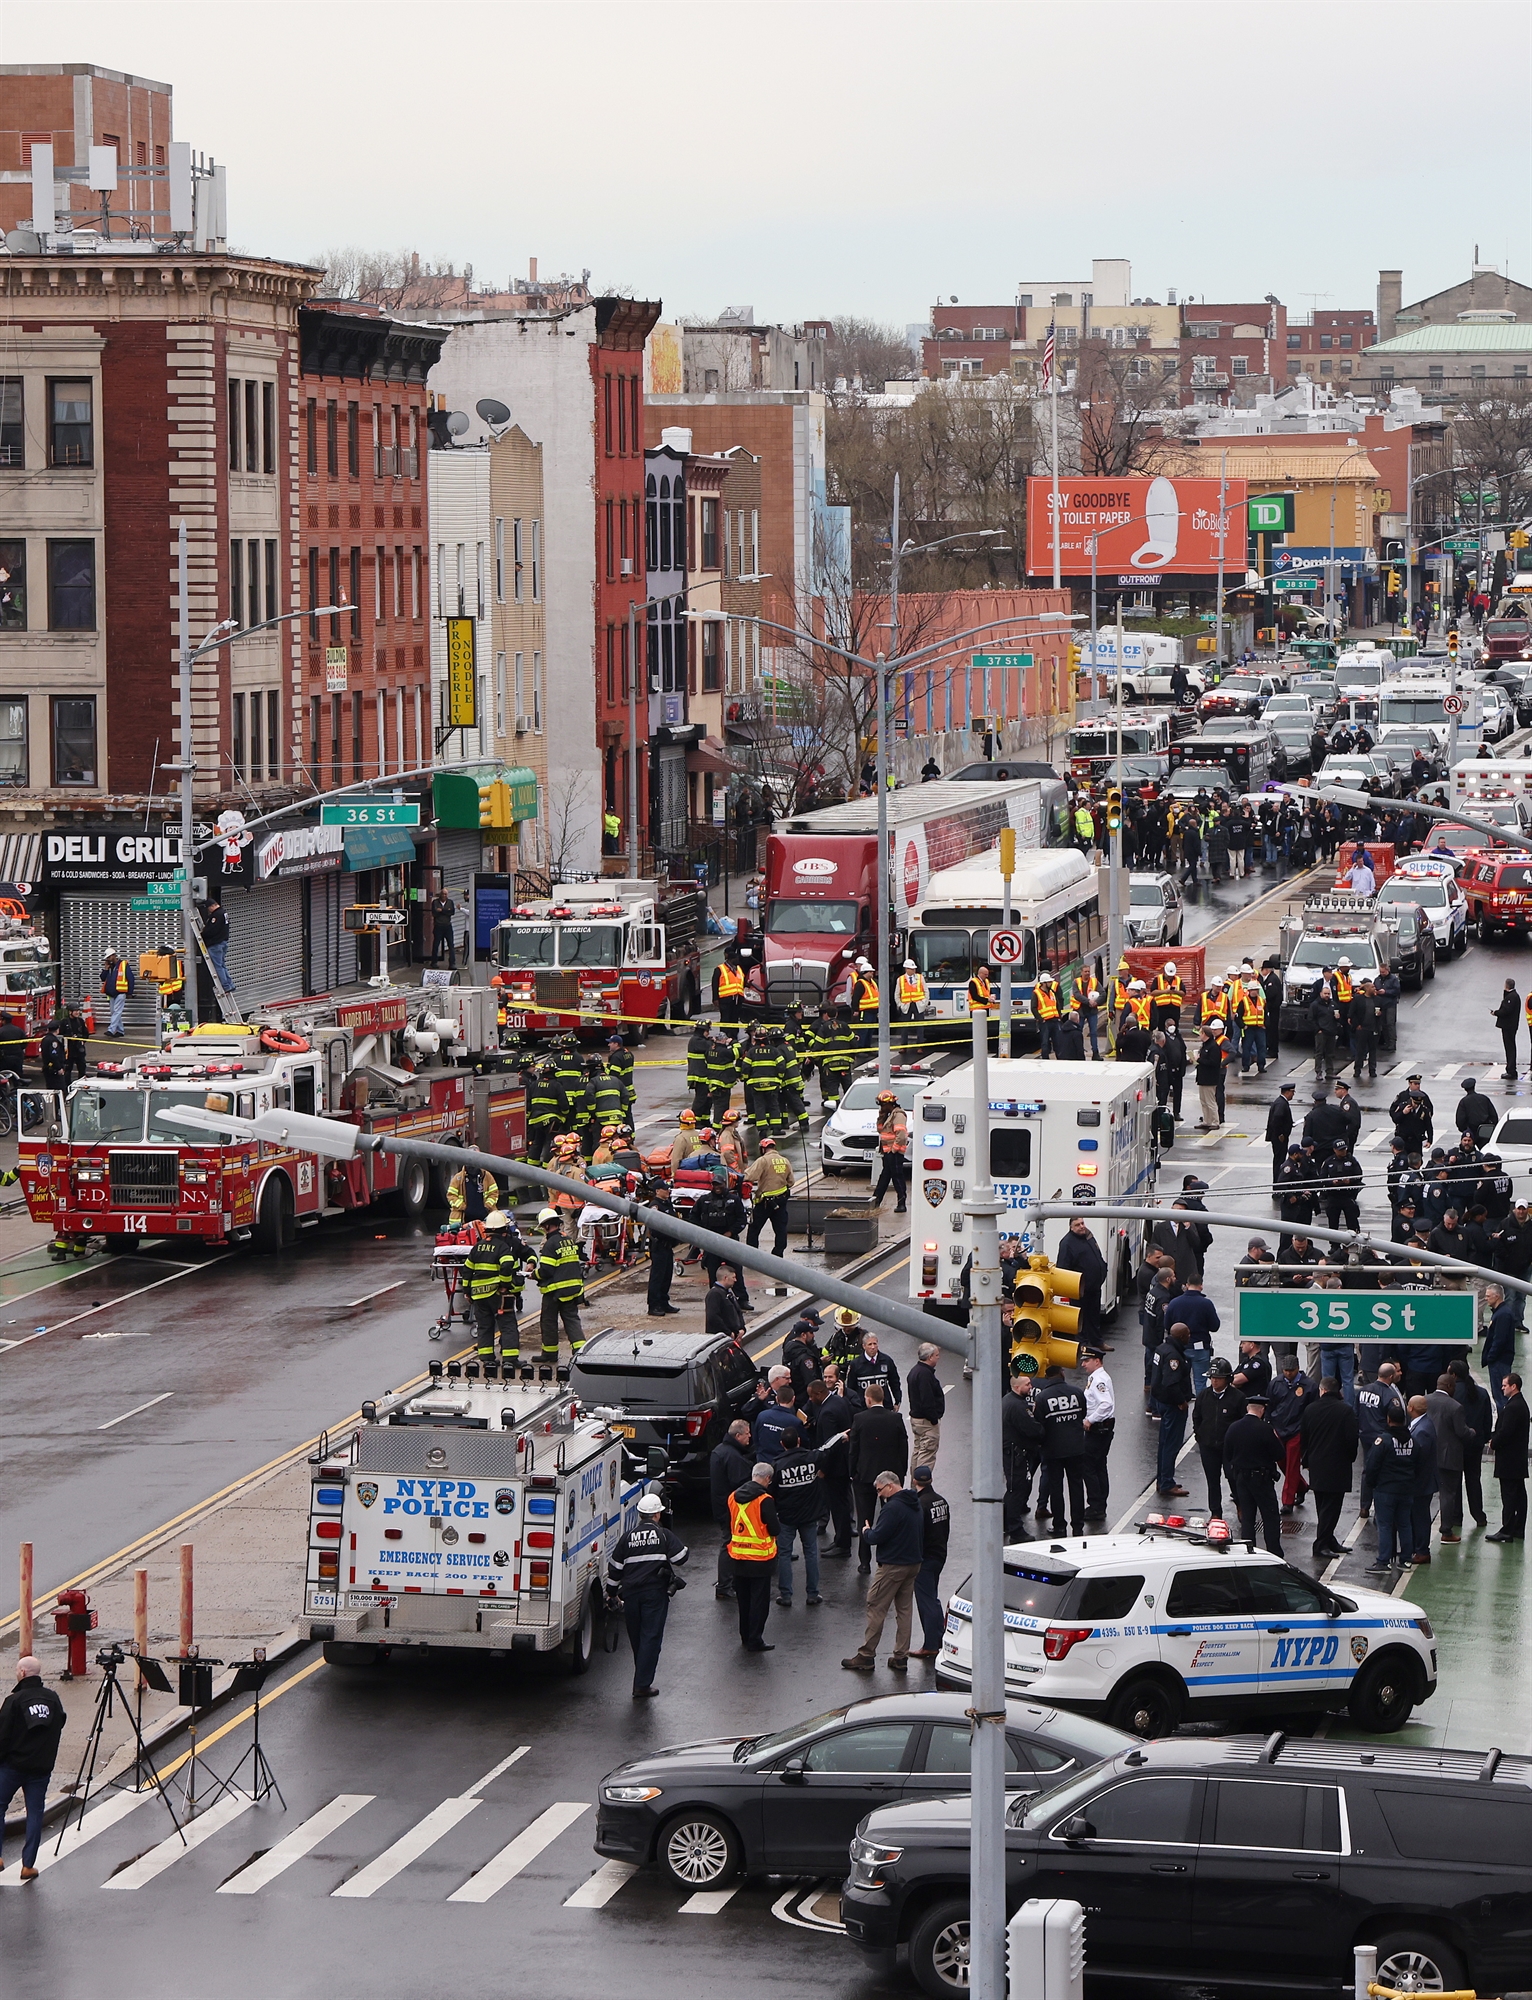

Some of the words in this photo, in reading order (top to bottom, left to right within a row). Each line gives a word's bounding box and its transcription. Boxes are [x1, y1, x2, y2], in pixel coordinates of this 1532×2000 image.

[1073, 493, 1131, 508] GOODBYE
[1047, 512, 1060, 524] T
[1063, 512, 1097, 524] TOILET
[1252, 504, 1281, 525] TD
[1120, 574, 1160, 585] OUTFRONT
[987, 656, 1001, 666] 37
[1004, 656, 1018, 666] St
[346, 809, 369, 822] 36
[375, 808, 396, 822] St
[47, 835, 106, 862] DELI
[263, 836, 284, 874] KING
[799, 862, 829, 871] JBS
[51, 870, 61, 878] HOT
[66, 871, 79, 879] COLD
[79, 871, 109, 879] SANDWICHES
[112, 871, 126, 879] SODA
[128, 871, 156, 879] BREAKFAST
[158, 872, 173, 880] LUNCH
[795, 875, 833, 885] CARRIERS
[152, 883, 165, 894] 36
[168, 883, 177, 891] ST
[1500, 893, 1525, 905] FDNY
[388, 913, 401, 921] WAY
[516, 927, 531, 935] GOD
[562, 926, 591, 934] AMERICA
[340, 1011, 363, 1028] LADDER
[362, 1010, 372, 1026] 114
[381, 1005, 397, 1022] TALLY
[506, 1014, 527, 1029] 201
[1074, 1184, 1095, 1193] POLICE
[31, 1193, 49, 1203] JIMMY
[77, 1189, 109, 1202] F.D.
[123, 1215, 147, 1232] 114
[477, 1243, 496, 1253] FDNY
[1297, 1301, 1350, 1331] 35
[1369, 1302, 1416, 1332] St
[1048, 1394, 1079, 1412] PBA
[1359, 1390, 1380, 1406] NYPD
[1056, 1414, 1078, 1423] NYPD
[781, 1463, 816, 1479] NYPD
[581, 1461, 603, 1500] POLICE
[782, 1473, 816, 1485] POLICE
[397, 1479, 476, 1499] NYPD
[383, 1498, 489, 1518] POLICE
[930, 1504, 949, 1520] FDNY
[630, 1529, 658, 1541] MTA
[628, 1540, 646, 1548] PHOTO
[379, 1550, 443, 1566] EMERGENCY
[446, 1553, 491, 1567] SERVICE
[368, 1569, 402, 1577] KEEP
[953, 1600, 973, 1613] NYPD
[1003, 1613, 1039, 1629] POLICE
[1383, 1619, 1410, 1629] POLICE
[1101, 1627, 1117, 1638] 4395
[1124, 1626, 1136, 1636] ESU
[1137, 1625, 1149, 1636] K-9
[1270, 1635, 1339, 1668] NYPD
[28, 1703, 51, 1716] NYPD
